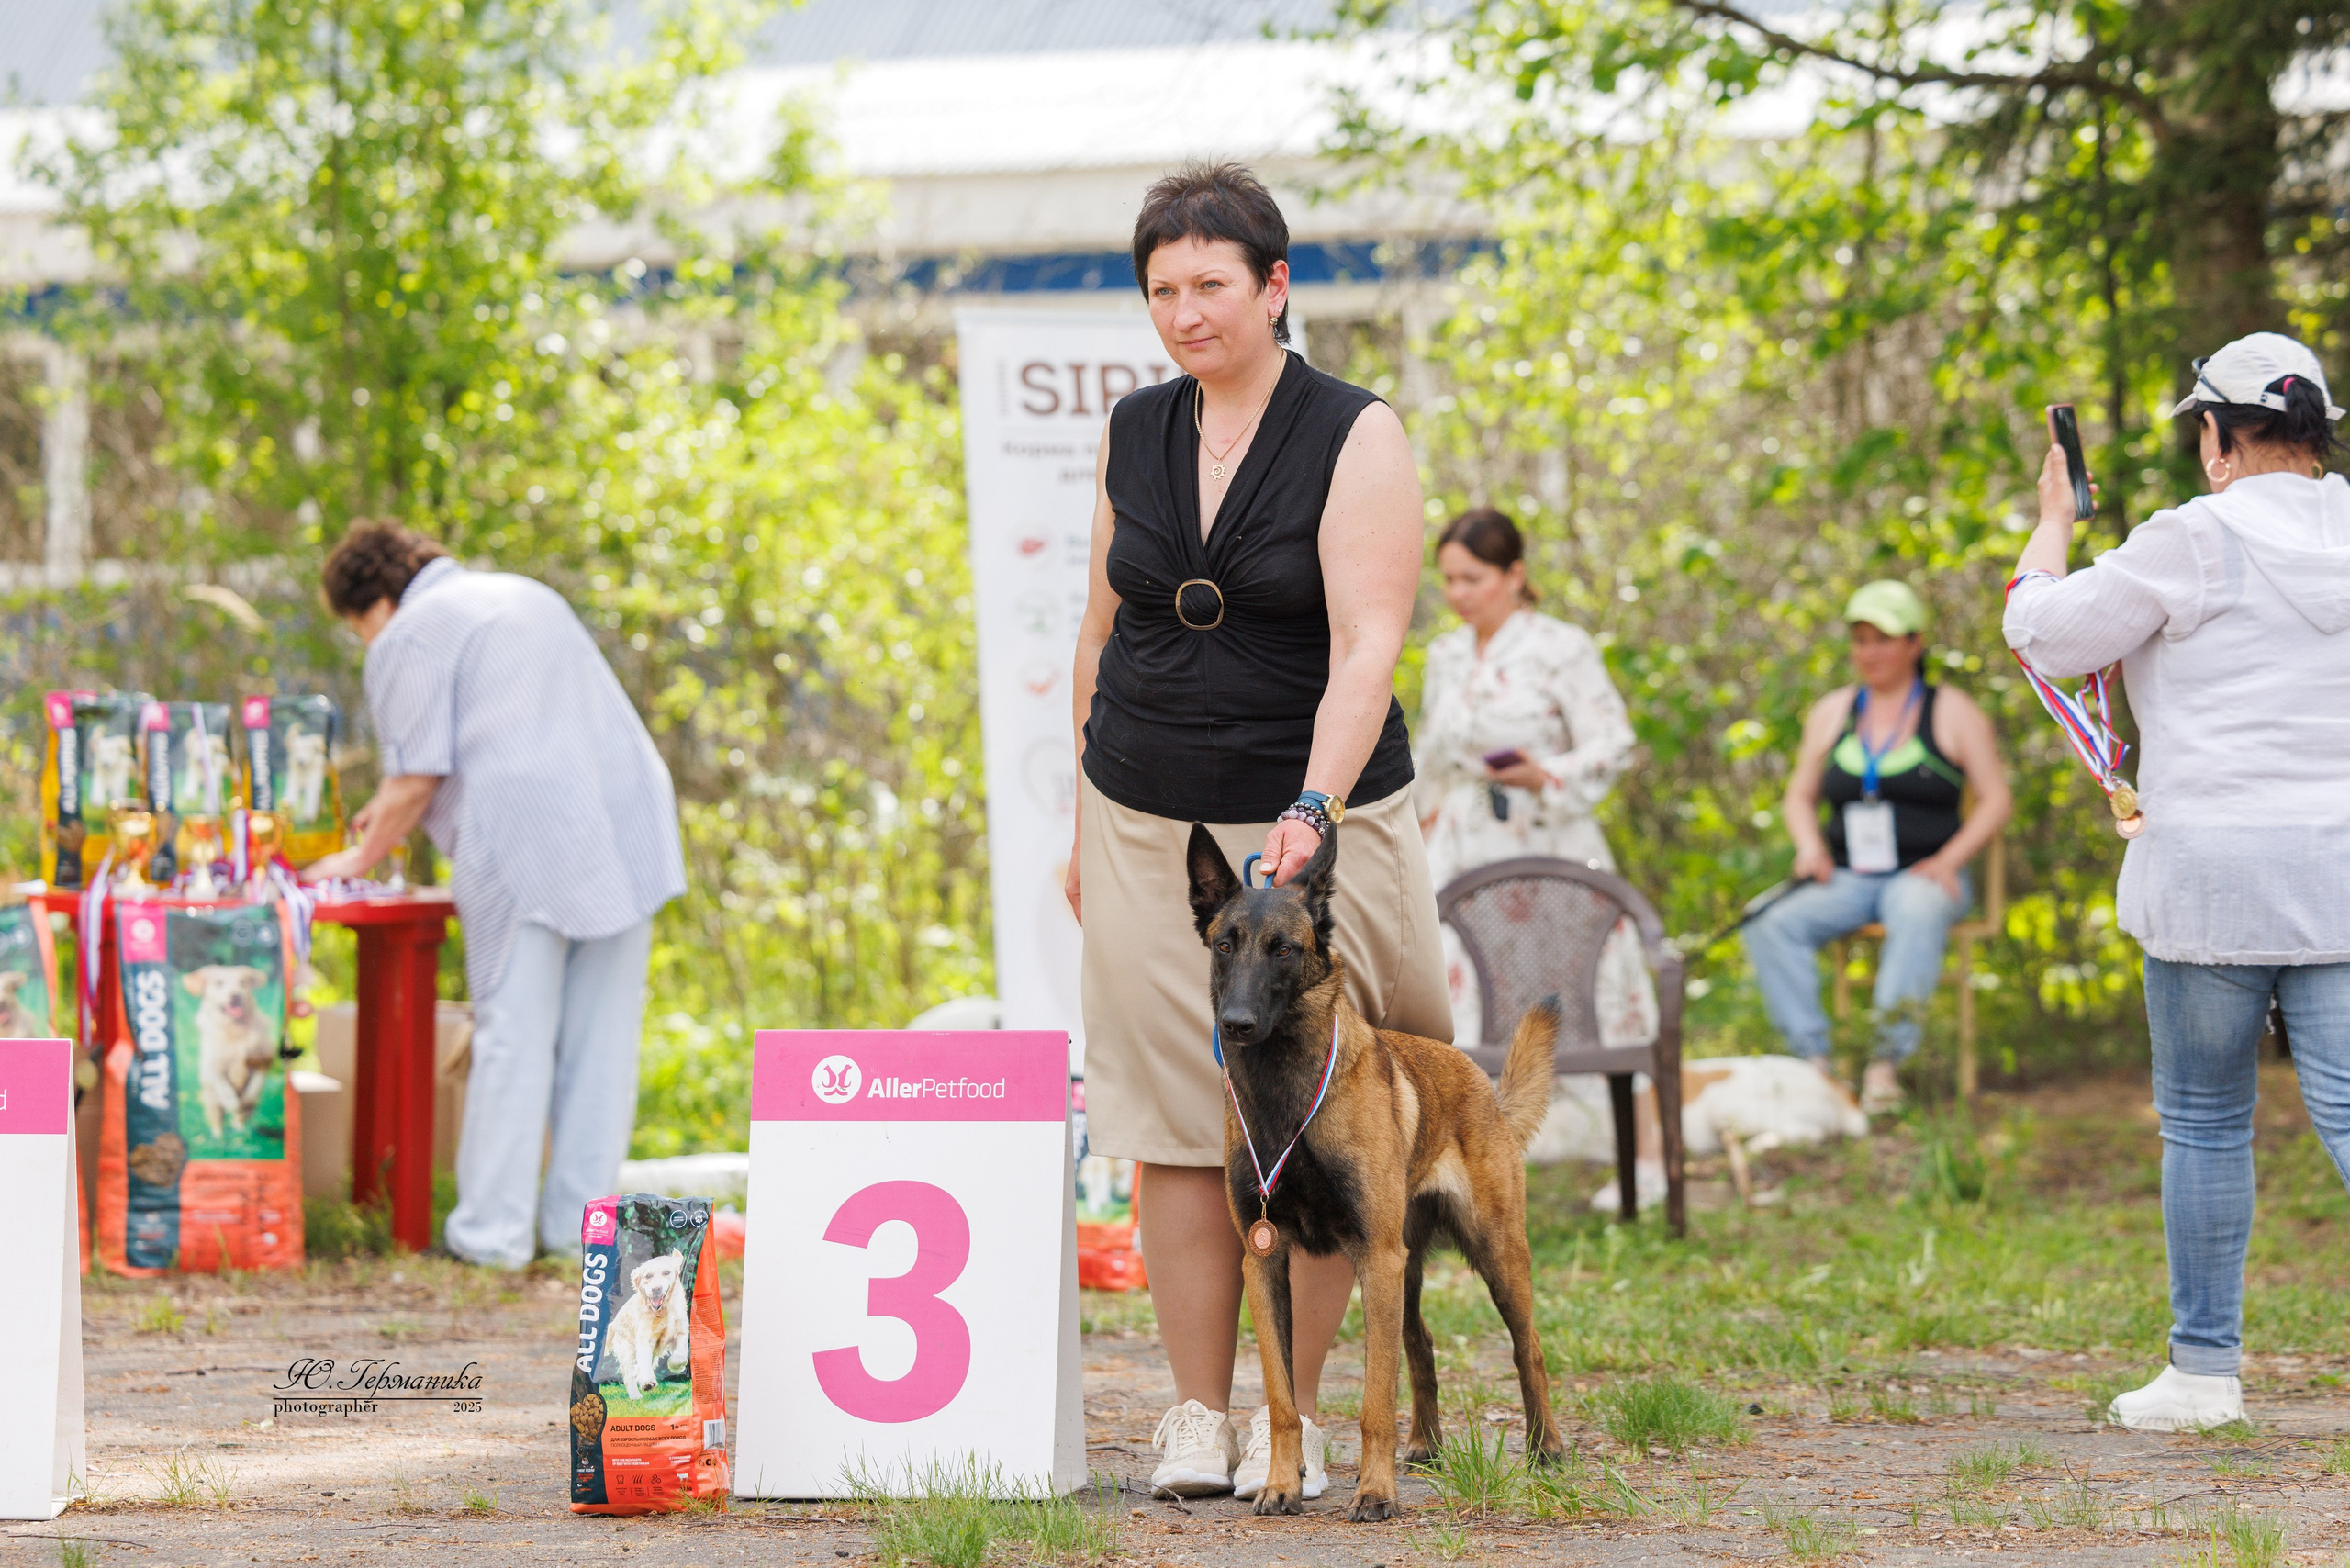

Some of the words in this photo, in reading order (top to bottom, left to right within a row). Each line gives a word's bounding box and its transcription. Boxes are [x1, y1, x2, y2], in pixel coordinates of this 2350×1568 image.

[136, 969, 169, 1053] DOGS
[139, 1052, 171, 1110] ALL
[867, 1077, 1006, 1099] AllerPetfood
[579, 1252, 608, 1322] DOGS
[811, 1180, 971, 1424] 3
[576, 1327, 598, 1373] ALL
